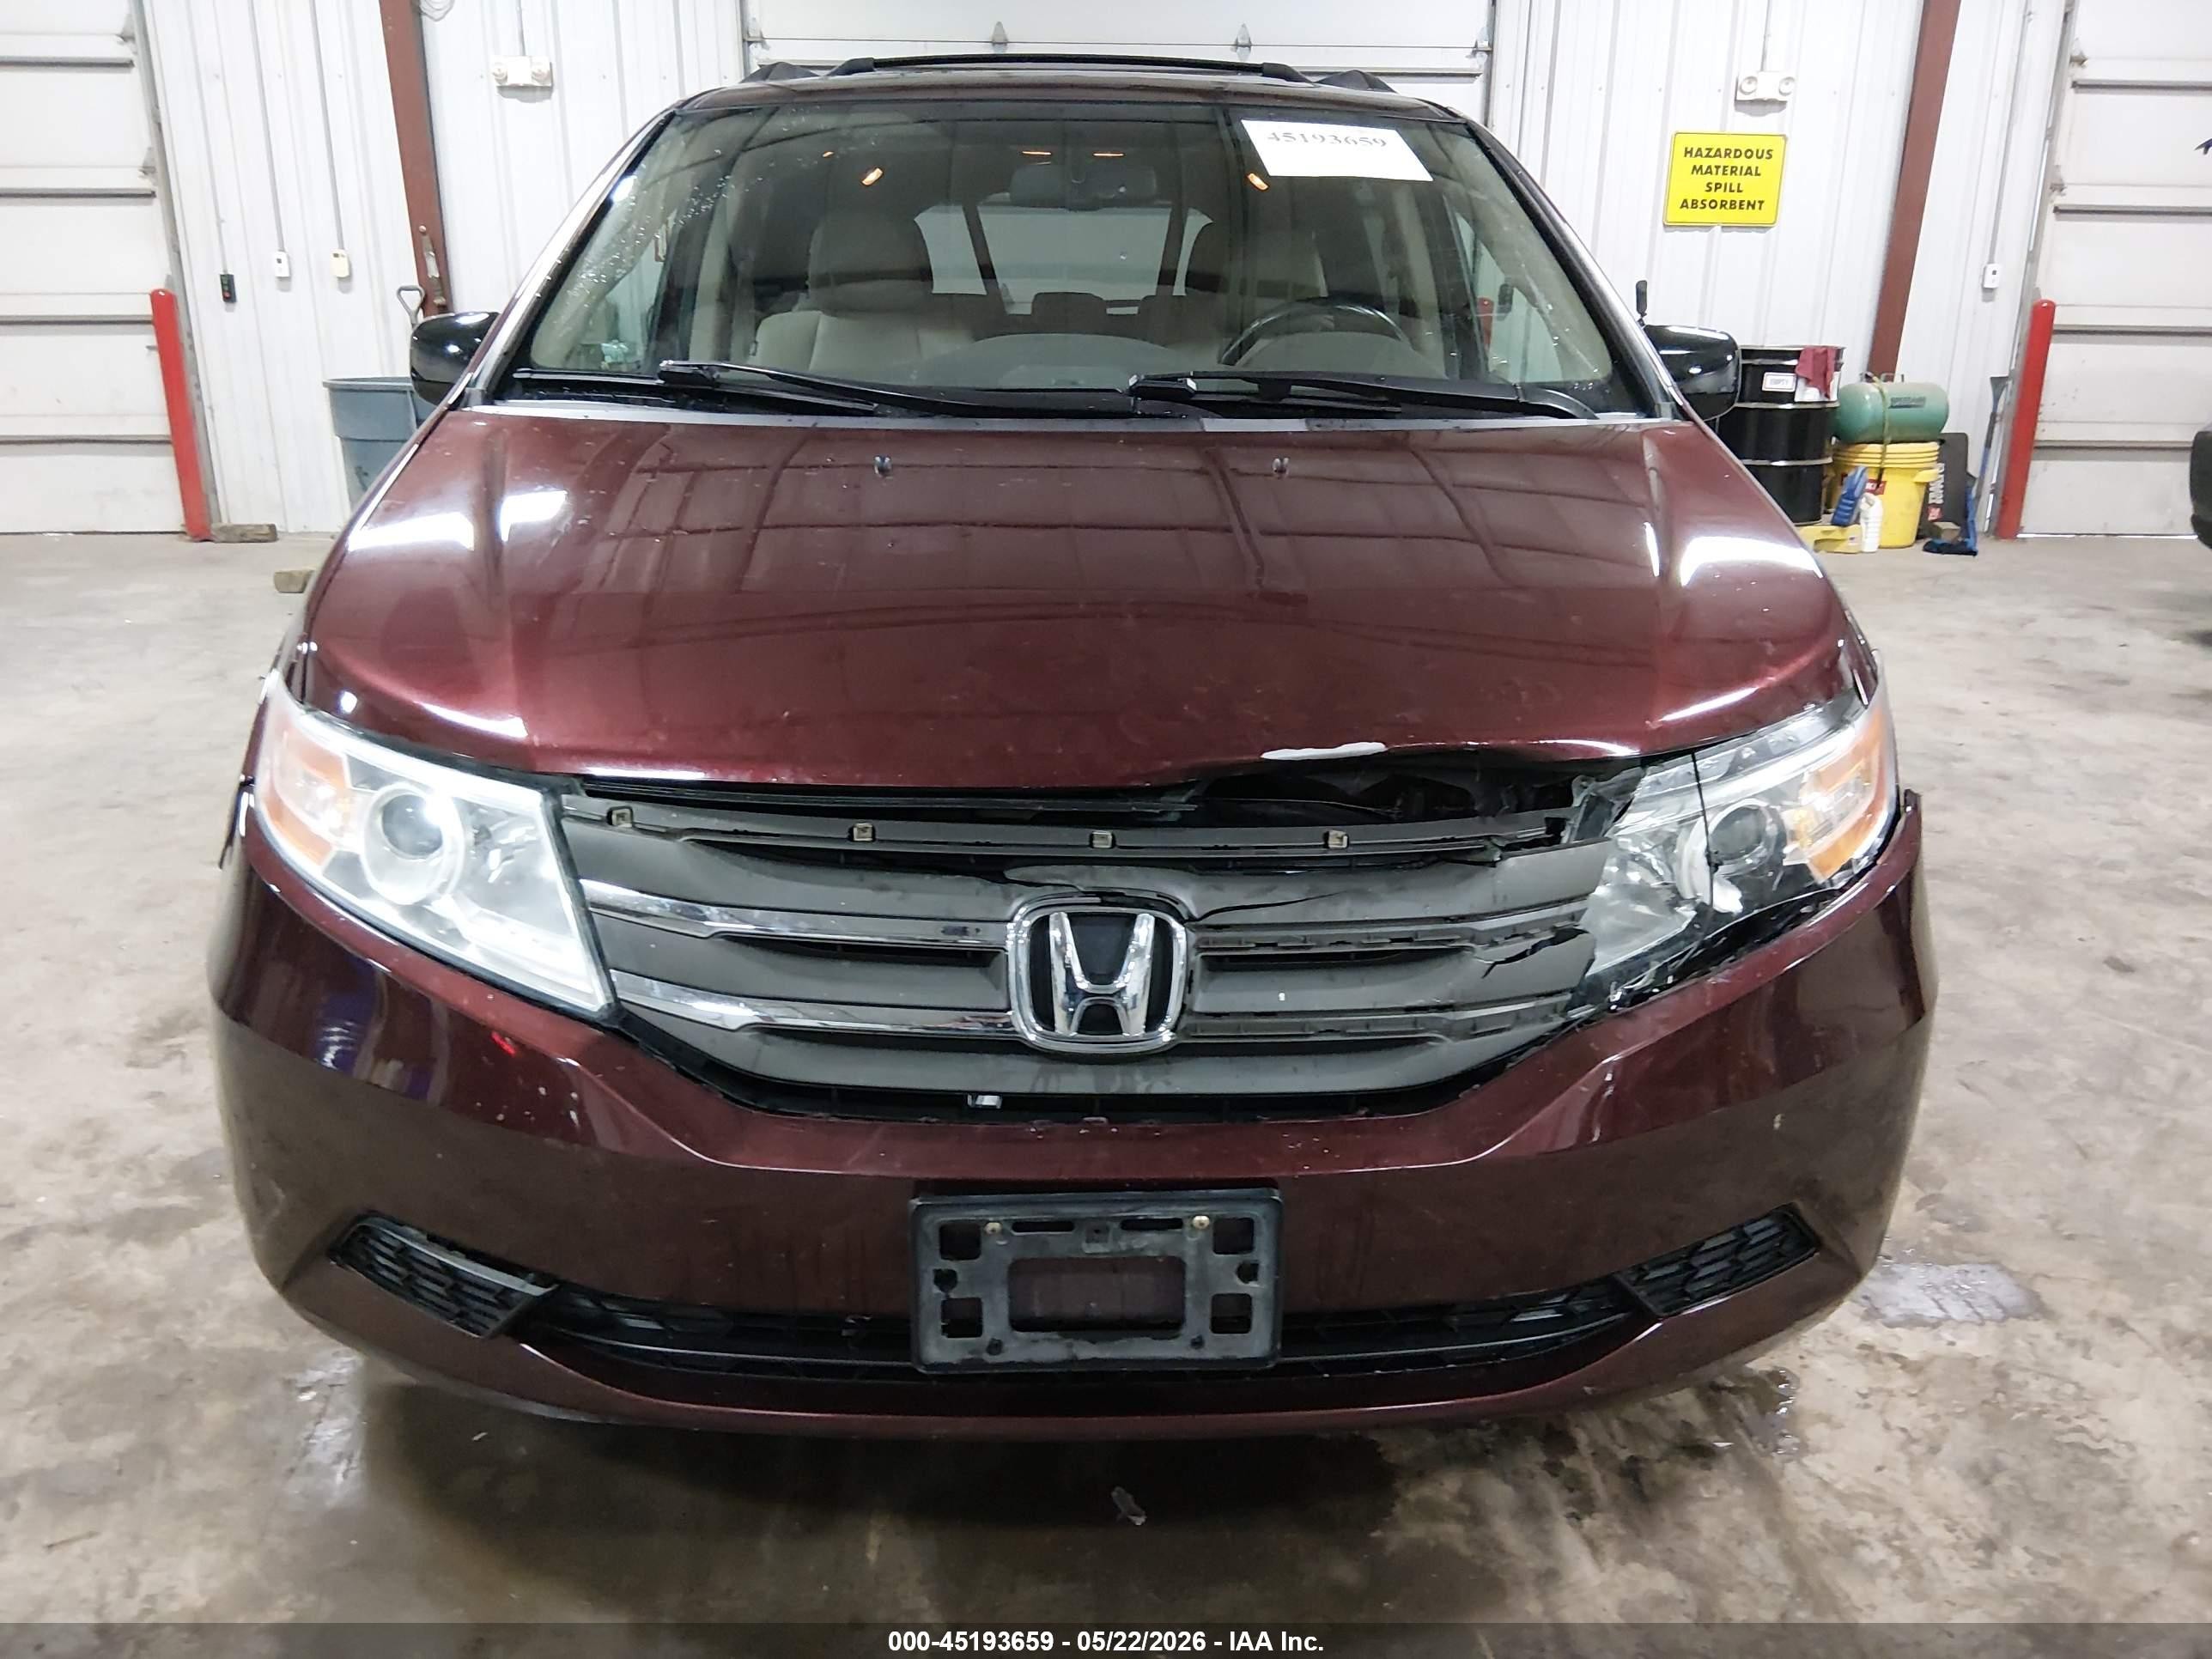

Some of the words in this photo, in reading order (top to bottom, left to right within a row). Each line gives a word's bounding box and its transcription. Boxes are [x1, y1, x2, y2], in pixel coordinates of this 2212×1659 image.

[1684, 147, 1773, 160] HAZARDOUS
[1691, 164, 1761, 176] MATERIAL
[1705, 182, 1743, 193] SPILL
[1680, 198, 1765, 210] ABSORBENT
